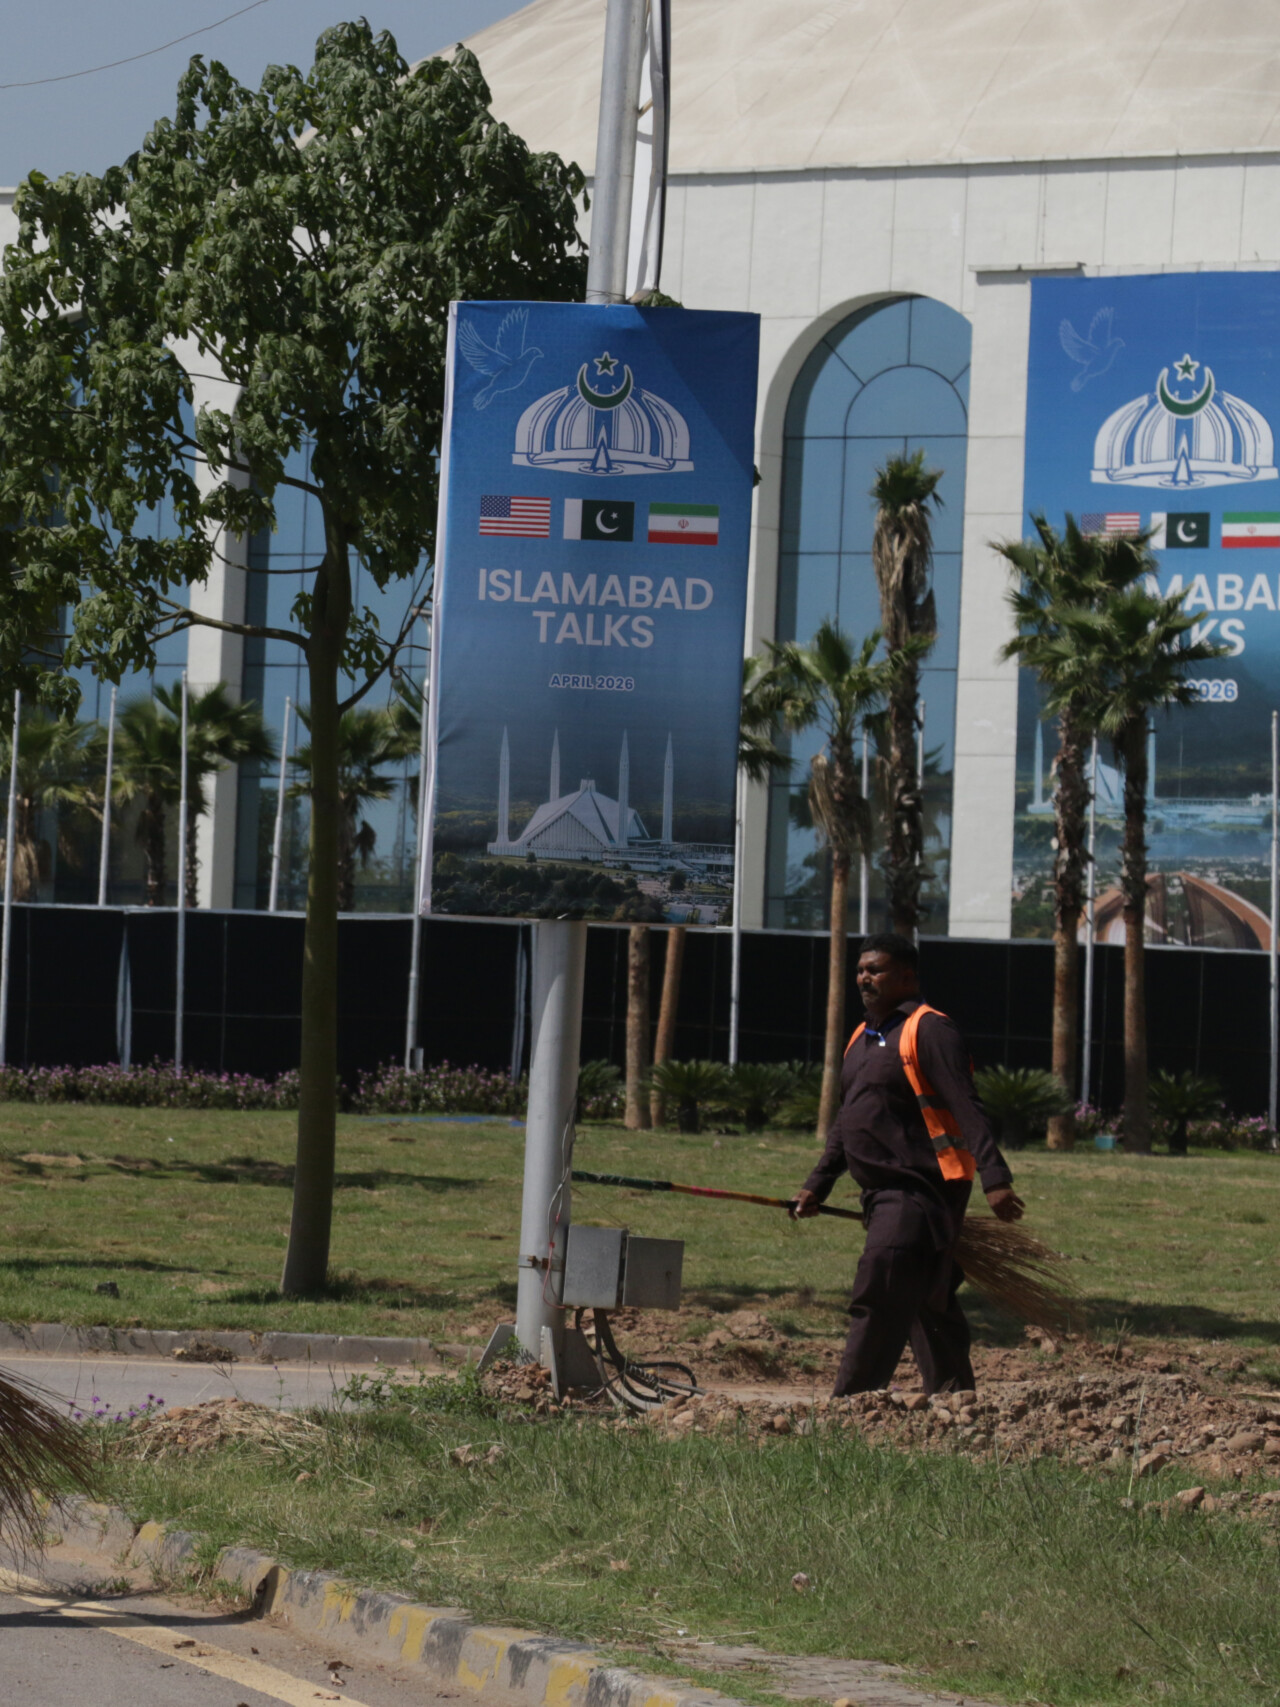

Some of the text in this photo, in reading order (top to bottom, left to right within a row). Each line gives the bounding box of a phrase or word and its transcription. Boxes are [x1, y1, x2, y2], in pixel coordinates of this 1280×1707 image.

[478, 568, 714, 611] ISLAMABAD
[532, 610, 655, 648] TALKS
[549, 674, 635, 691] APRIL 2026
